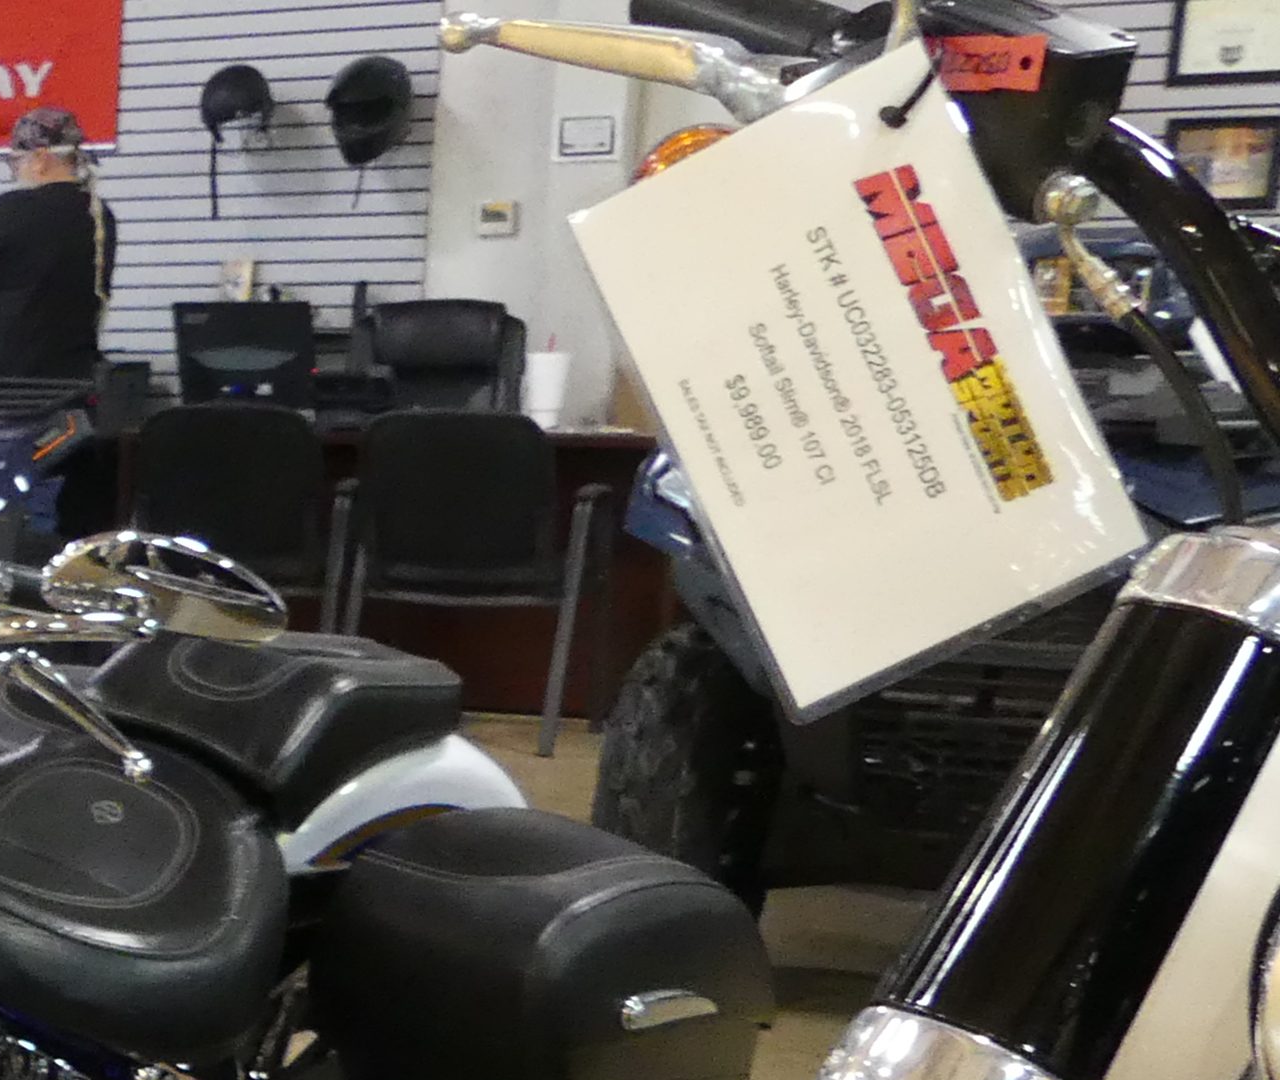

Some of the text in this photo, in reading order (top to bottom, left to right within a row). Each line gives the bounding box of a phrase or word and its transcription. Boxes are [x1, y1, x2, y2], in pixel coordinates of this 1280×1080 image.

[803, 224, 841, 273] STK
[826, 270, 848, 291] #
[852, 161, 998, 383] MEGA
[722, 372, 784, 471] $9,989.00
[746, 321, 785, 377] Softail
[797, 430, 826, 464] 107
[765, 262, 895, 506] Harley-Davidson® 2018 FLSL
